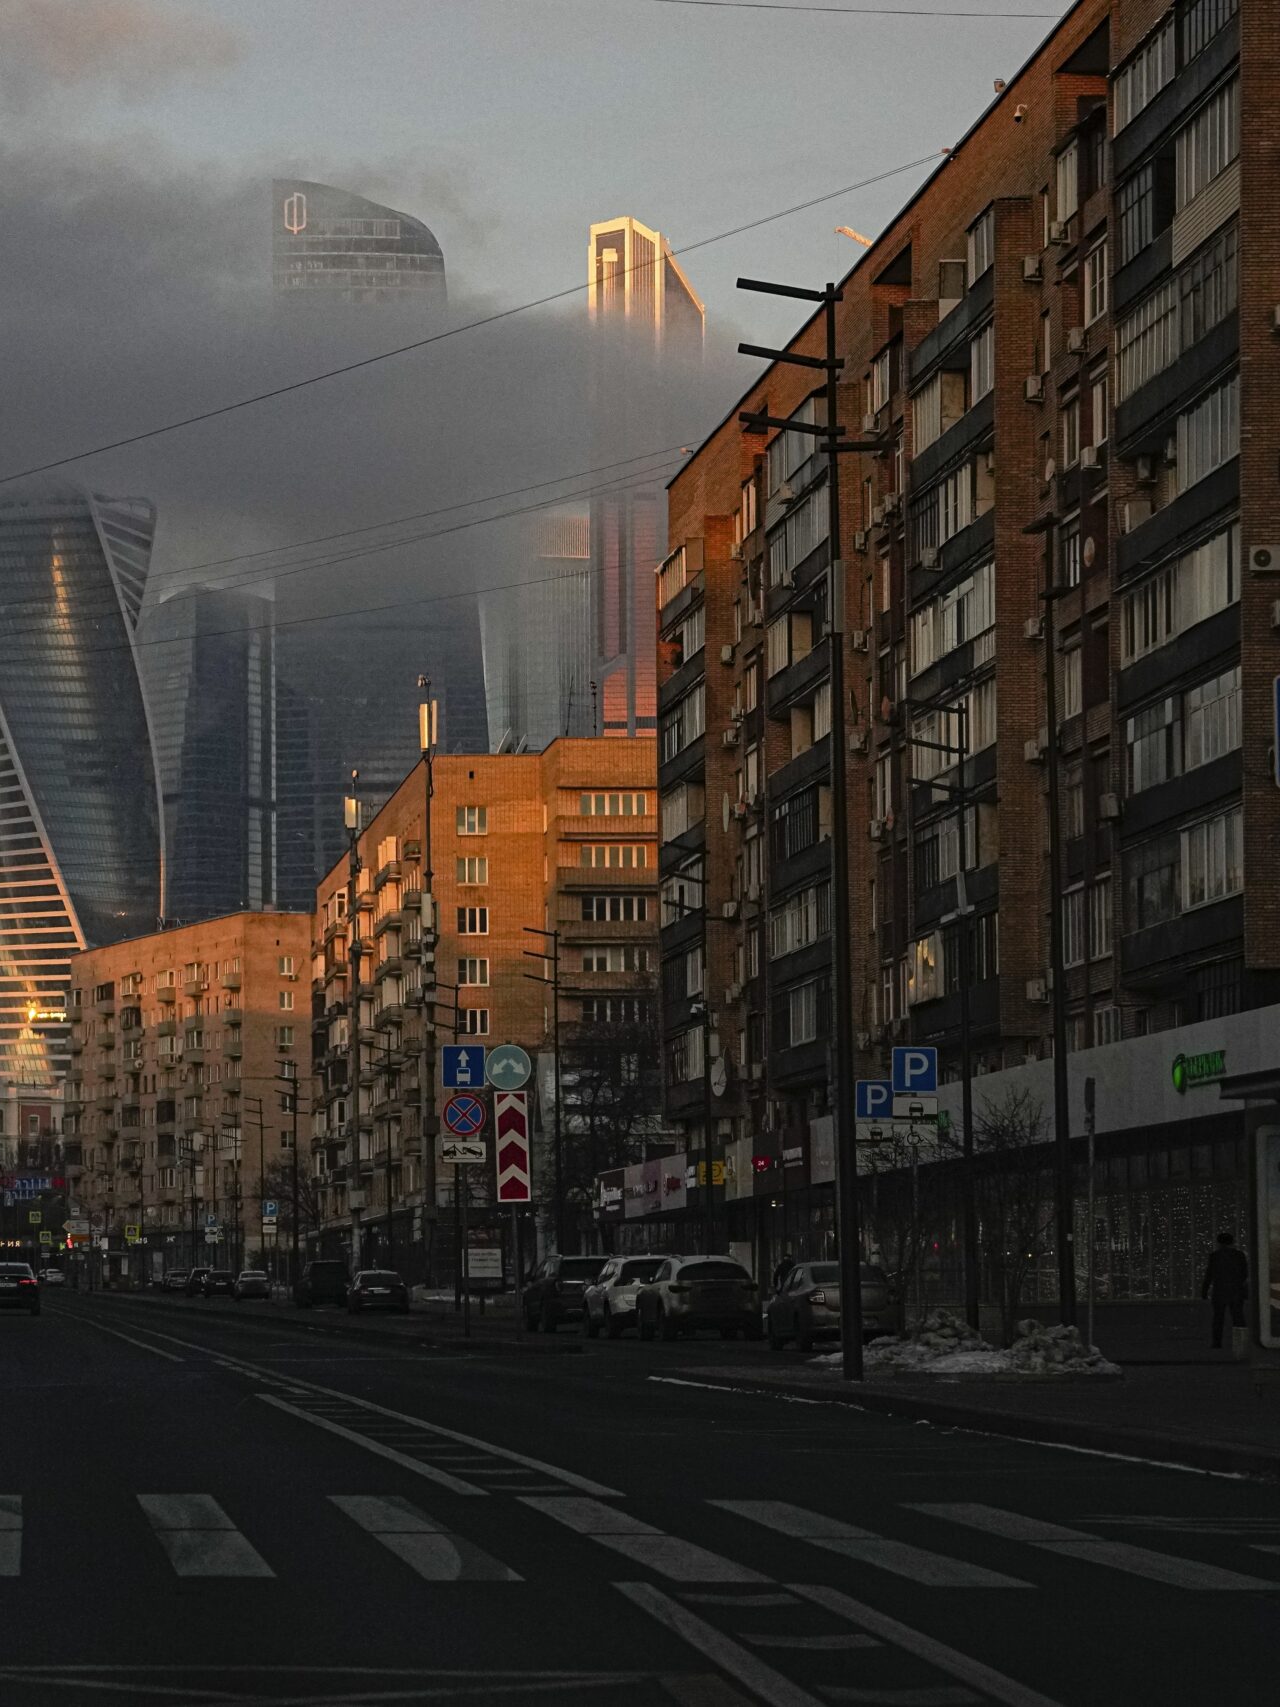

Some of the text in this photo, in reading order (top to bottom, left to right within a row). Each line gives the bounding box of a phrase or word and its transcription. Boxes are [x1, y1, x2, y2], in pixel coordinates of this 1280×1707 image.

[904, 1052, 929, 1088] P
[866, 1084, 888, 1115] P
[266, 1202, 276, 1214] P
[207, 1214, 216, 1225] P
